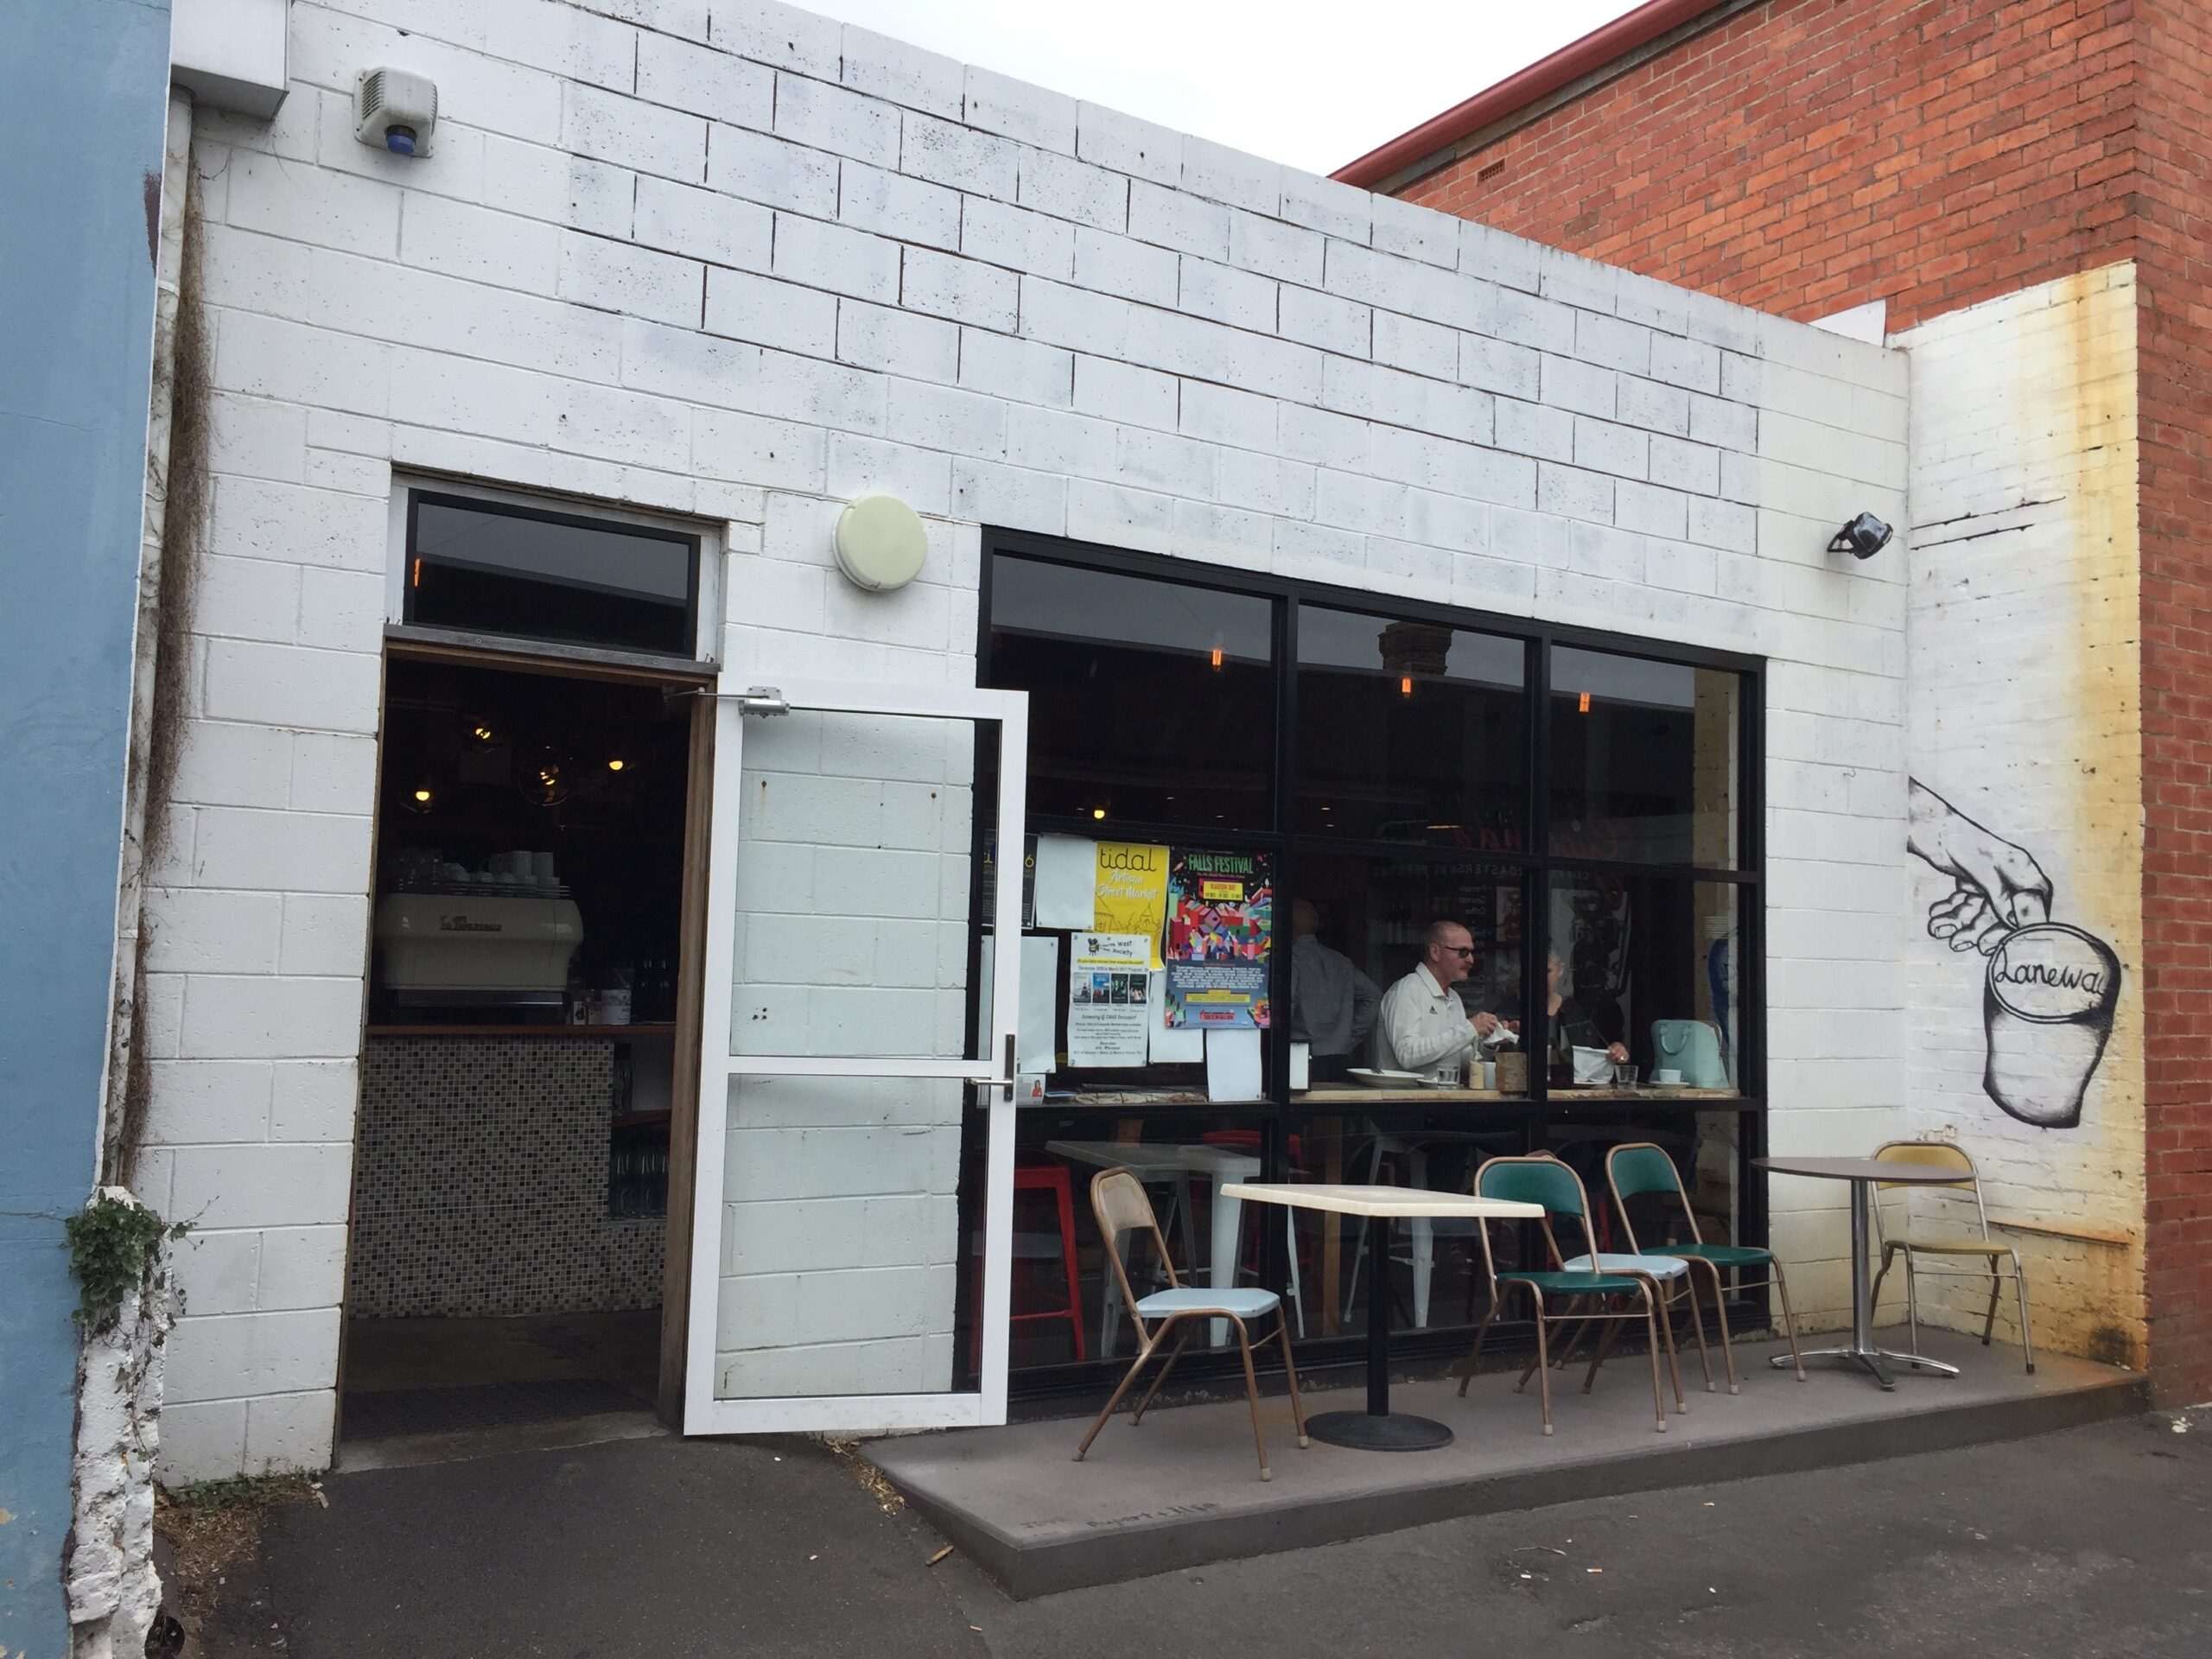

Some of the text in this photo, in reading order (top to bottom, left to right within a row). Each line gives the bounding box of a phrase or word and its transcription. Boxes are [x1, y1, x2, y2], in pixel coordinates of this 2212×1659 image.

[1100, 848, 1156, 872] tidal
[1188, 854, 1254, 874] FALLS FESTIVAL
[1109, 870, 1143, 884] Artisan
[1096, 884, 1159, 899] Street Market
